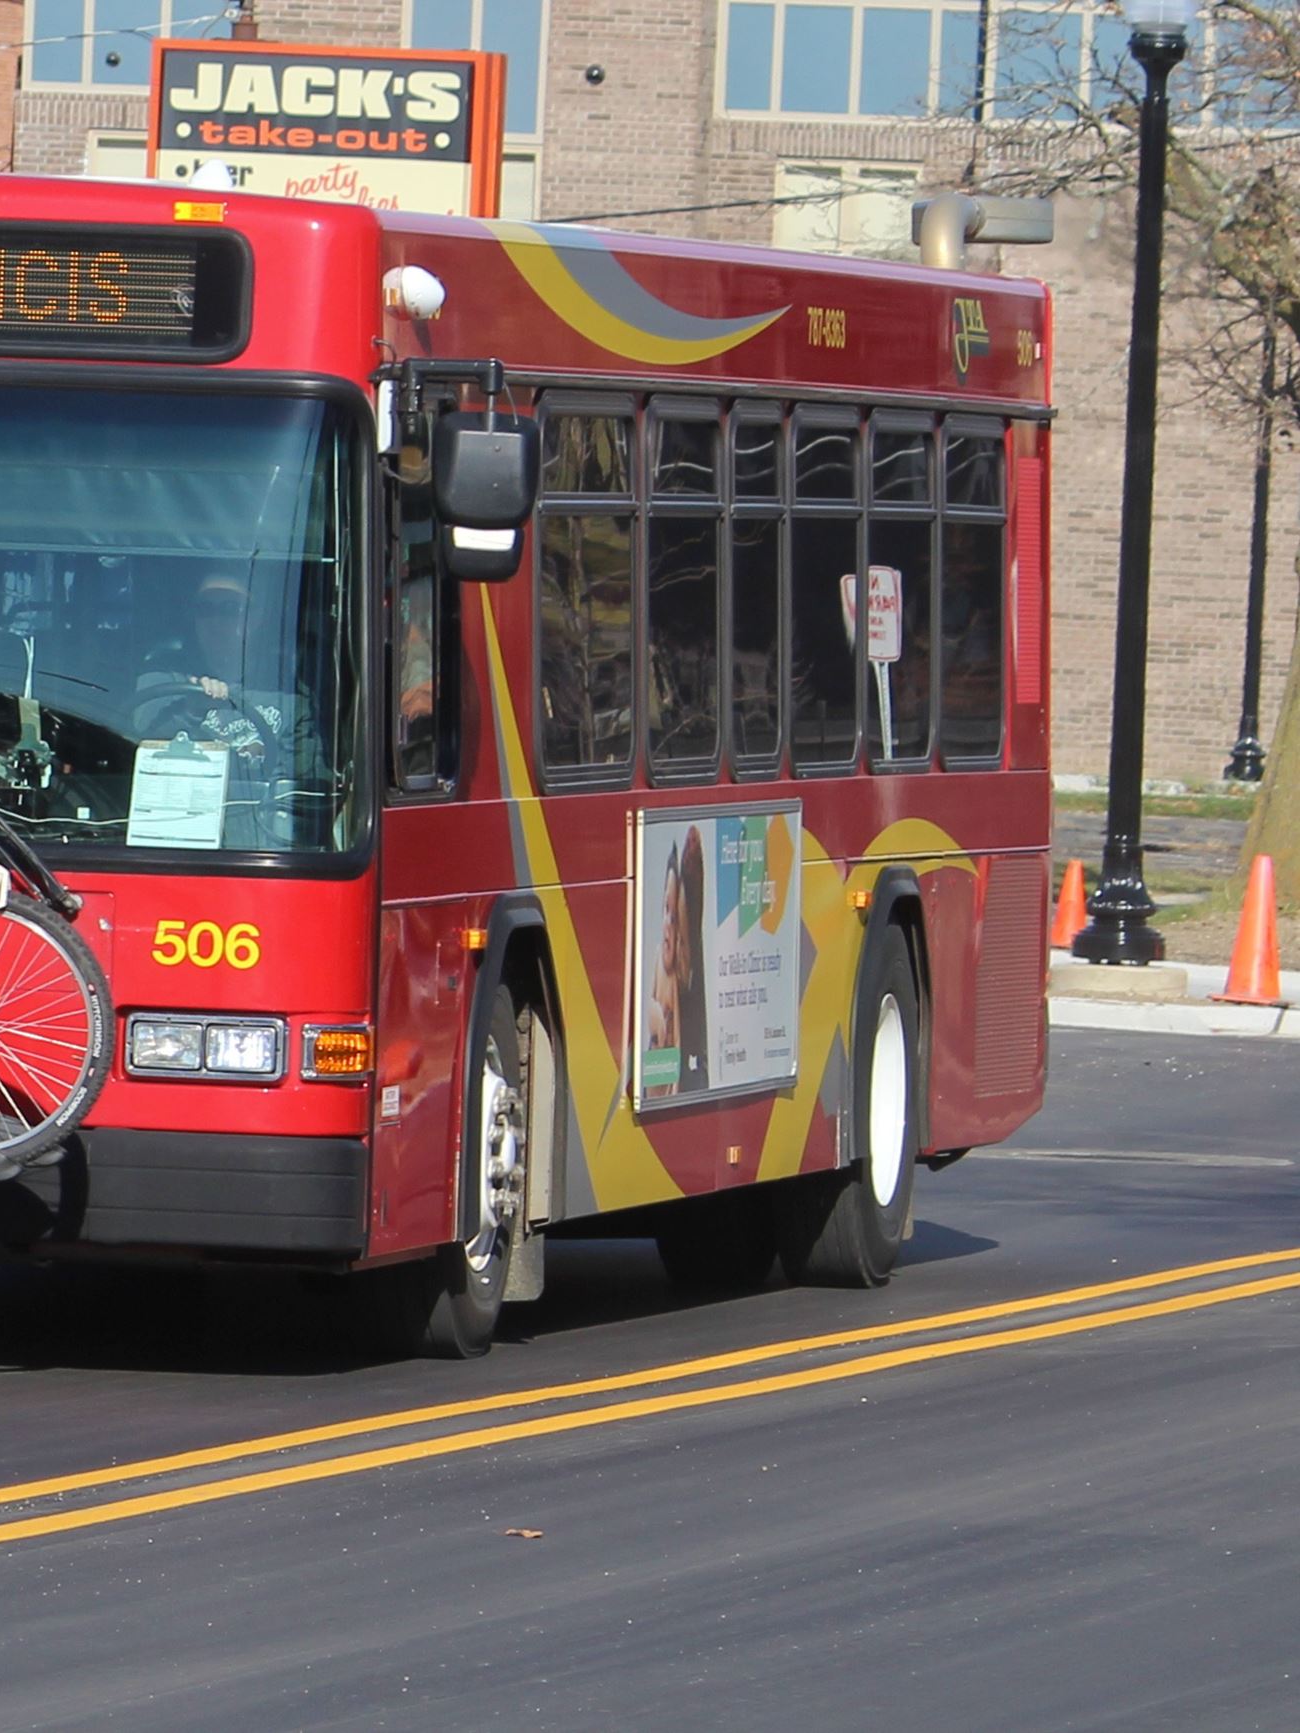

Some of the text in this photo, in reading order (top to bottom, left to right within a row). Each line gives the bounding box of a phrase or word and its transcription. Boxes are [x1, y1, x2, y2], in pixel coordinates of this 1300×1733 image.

[169, 62, 462, 122] JACK'S
[198, 119, 428, 153] take-out
[284, 163, 360, 199] party
[721, 834, 738, 864] Here
[741, 875, 762, 914] Every
[151, 919, 260, 970] 506
[91, 995, 102, 1058] HUTCHINSON
